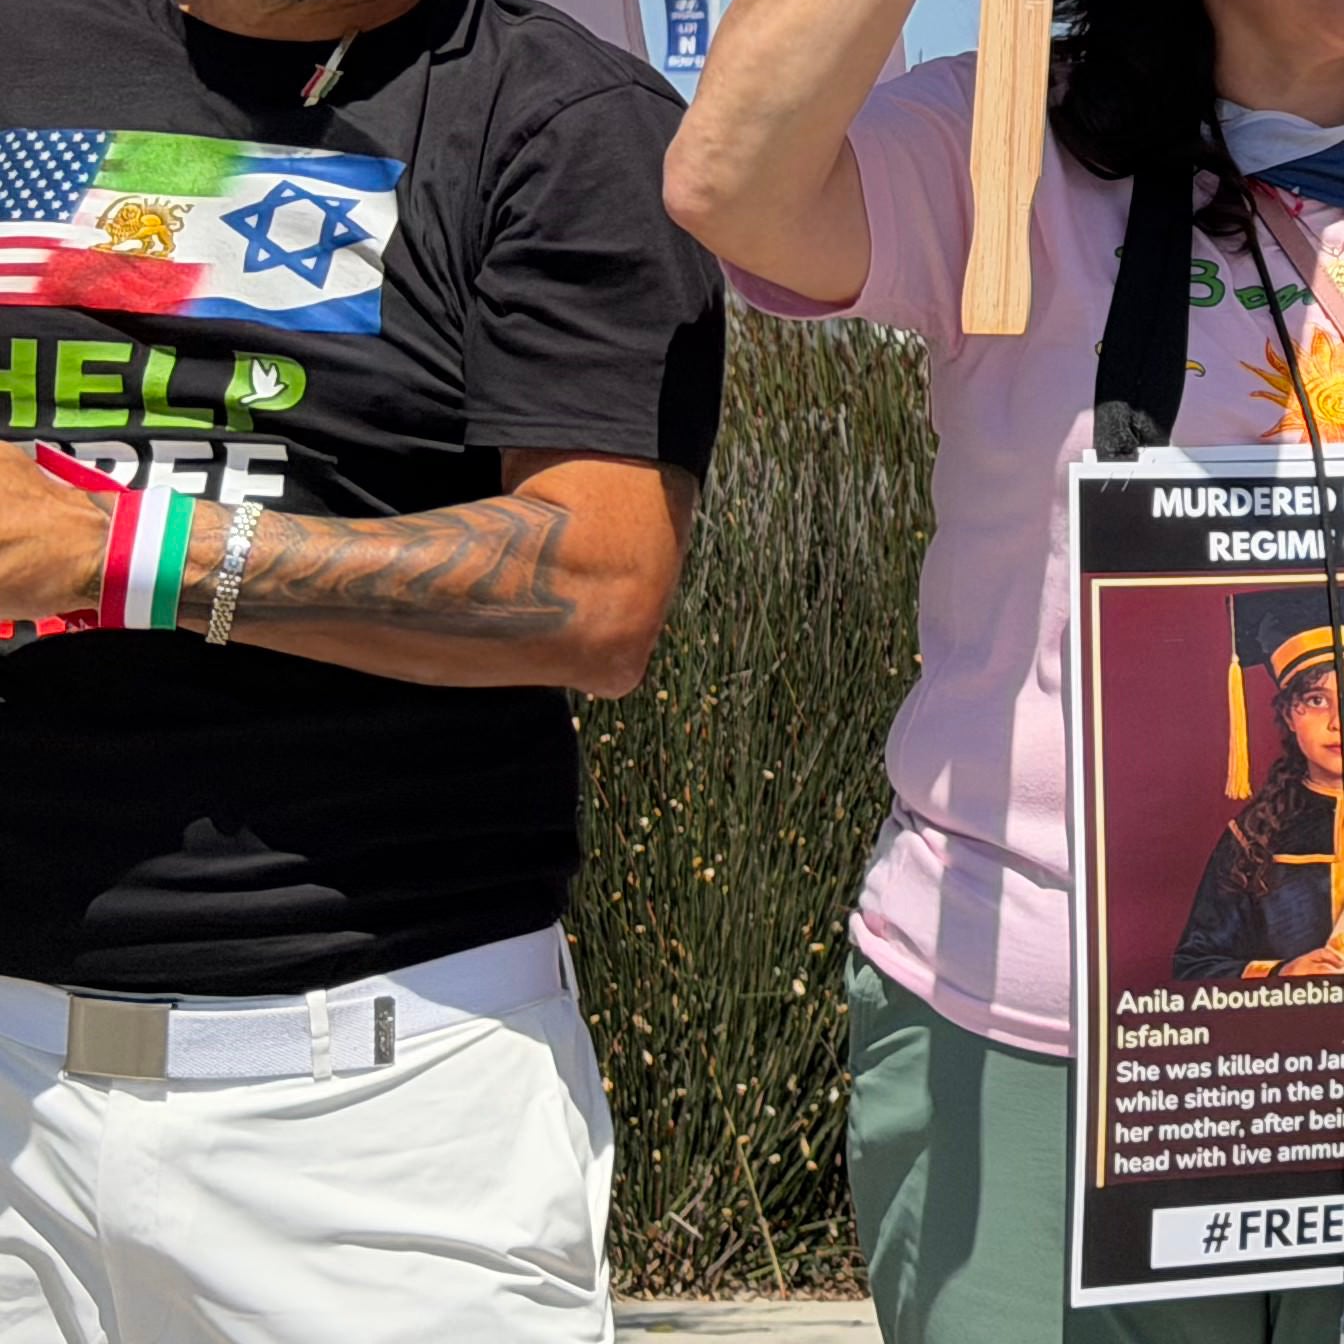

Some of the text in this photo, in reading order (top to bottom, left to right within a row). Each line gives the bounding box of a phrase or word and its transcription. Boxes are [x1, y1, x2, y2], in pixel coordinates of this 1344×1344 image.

[1152, 485, 1337, 518] MURDERED
[1116, 989, 1184, 1014] Anila
[1117, 1023, 1210, 1049] Isfahan
[1116, 1061, 1160, 1083] She
[1165, 1062, 1212, 1080] was
[1217, 1052, 1280, 1077] killed
[1284, 1055, 1313, 1073] on
[1115, 1090, 1178, 1113] while
[1184, 1085, 1255, 1108] sitting
[1260, 1082, 1281, 1104] in
[1286, 1080, 1324, 1102] the
[1115, 1122, 1153, 1144] her
[1158, 1115, 1245, 1142] mother,
[1250, 1112, 1305, 1135] after
[1114, 1149, 1169, 1175] head
[1175, 1144, 1226, 1170] with
[1232, 1143, 1272, 1165] live
[1202, 1203, 1344, 1254] #FREE
